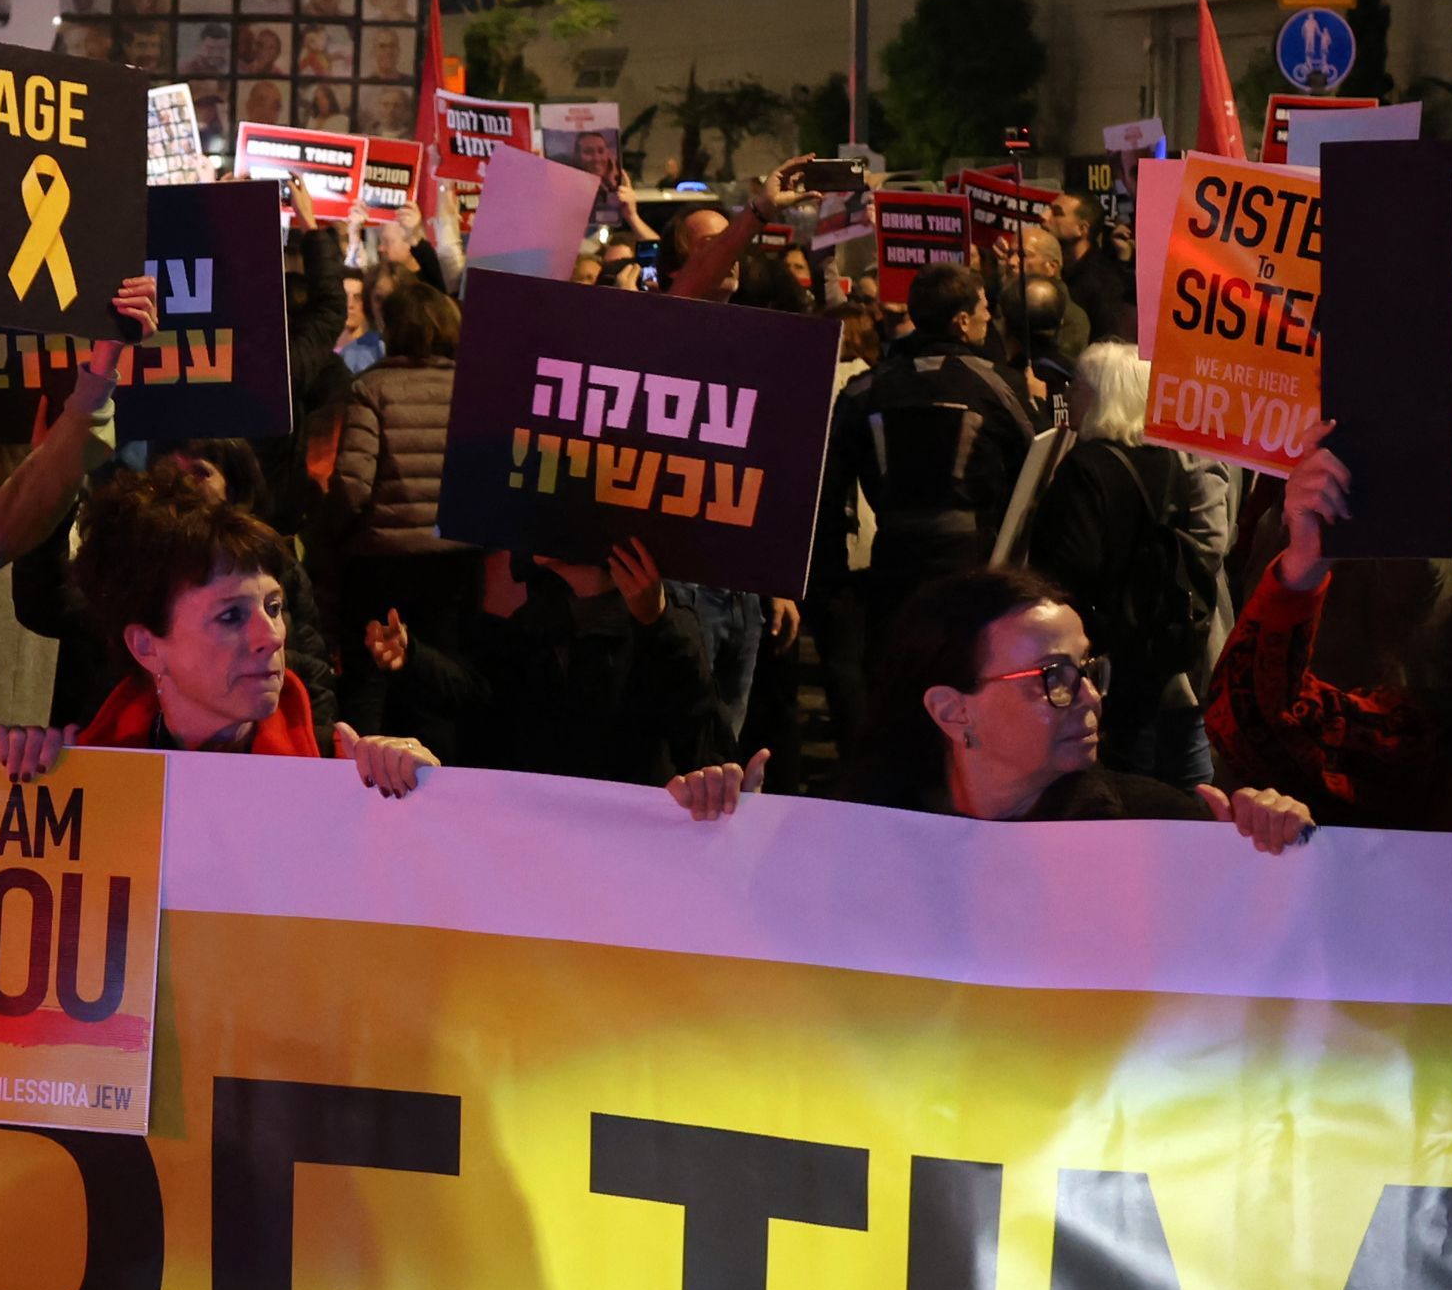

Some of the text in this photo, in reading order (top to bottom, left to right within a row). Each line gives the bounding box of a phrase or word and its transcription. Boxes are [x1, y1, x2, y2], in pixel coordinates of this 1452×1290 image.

[304, 145, 354, 169] THEM
[455, 131, 495, 158] זמן!
[881, 210, 963, 233] BRING THEM
[1188, 176, 1324, 262] SISTE
[886, 245, 927, 266] HOME
[1258, 254, 1276, 280] To
[1195, 355, 1301, 398] WE ARE HERE
[531, 356, 759, 449] עסקה
[1152, 372, 1230, 440] FOR
[1241, 390, 1319, 459] YOU
[507, 426, 766, 528] עכשיו!
